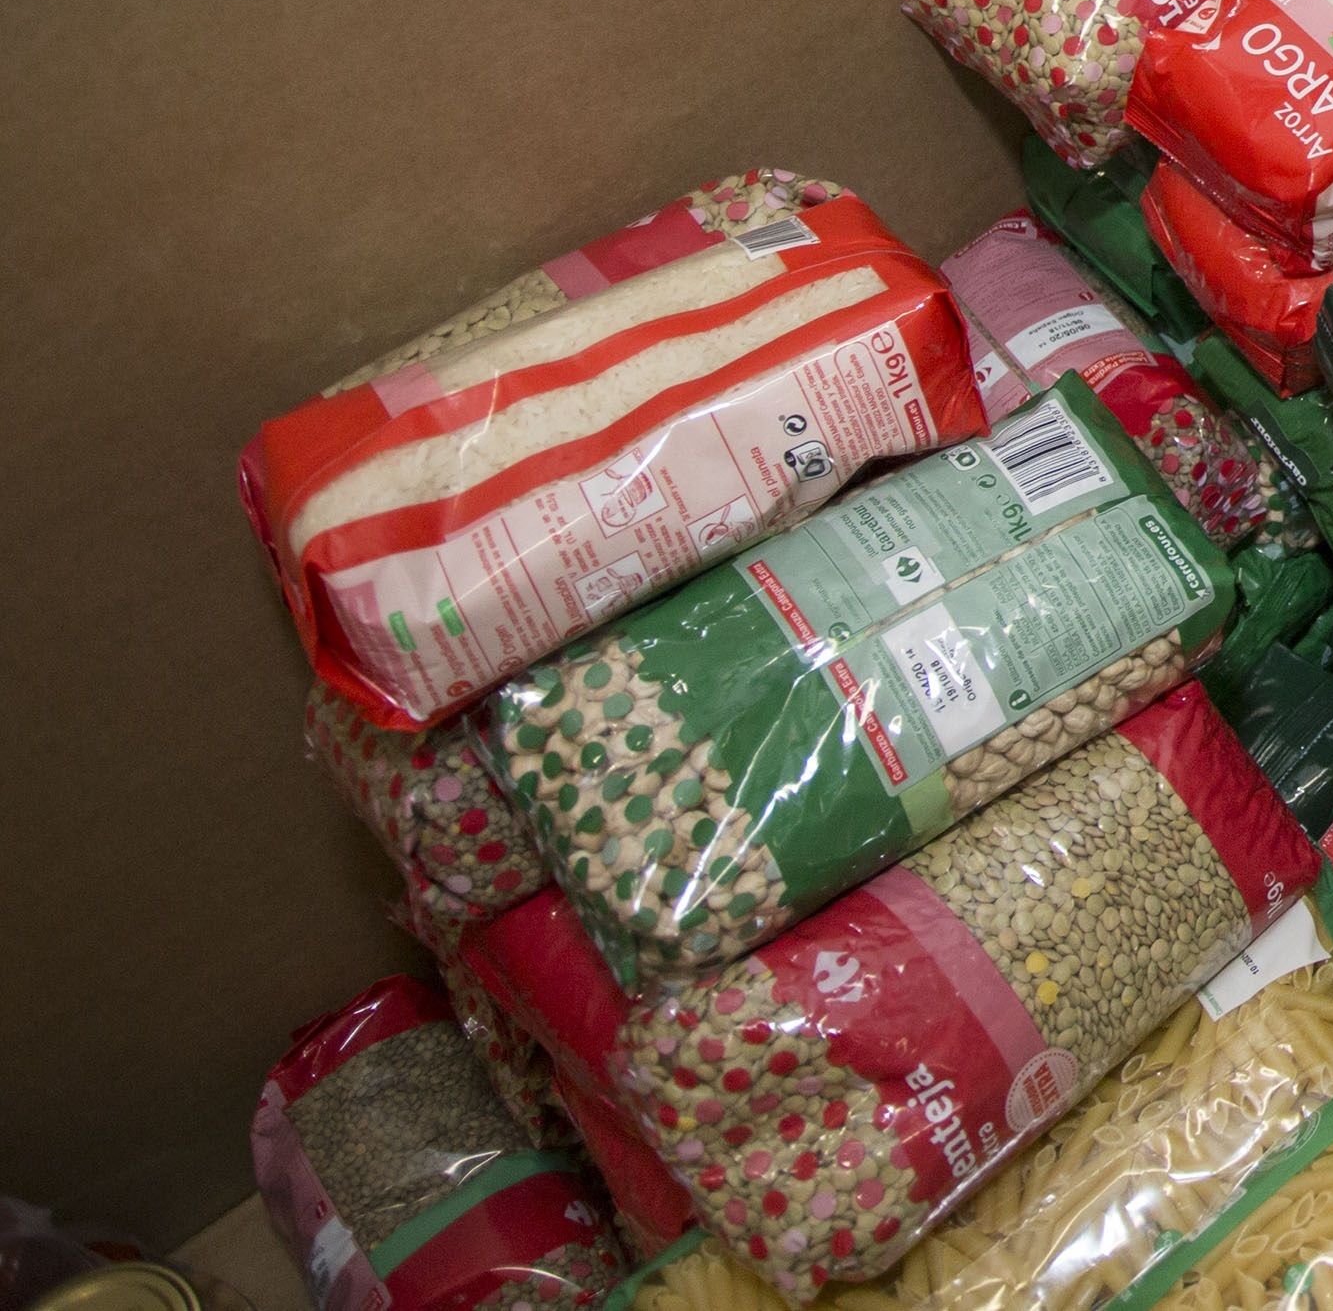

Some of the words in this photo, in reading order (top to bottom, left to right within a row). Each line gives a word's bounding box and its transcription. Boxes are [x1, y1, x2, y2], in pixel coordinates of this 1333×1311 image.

[1275, 103, 1333, 161] Arroz
[1047, 320, 1091, 344] 06/05/20
[847, 351, 868, 379] España
[850, 383, 870, 414] Carrefour
[860, 380, 879, 410] MADRID
[749, 444, 778, 487] planeta
[1247, 415, 1309, 486] Carrefour
[851, 503, 897, 553] Carrefour
[883, 511, 911, 544] sabemos
[751, 560, 770, 580] Extra
[1143, 516, 1201, 589] carrefour.es
[787, 608, 817, 646] arbanzo.
[834, 660, 853, 688] Extra
[927, 658, 962, 704] 19/10/18
[873, 730, 903, 783] Garbanzo.
[904, 1063, 970, 1182] enteja
[974, 1120, 1005, 1168] xtra
